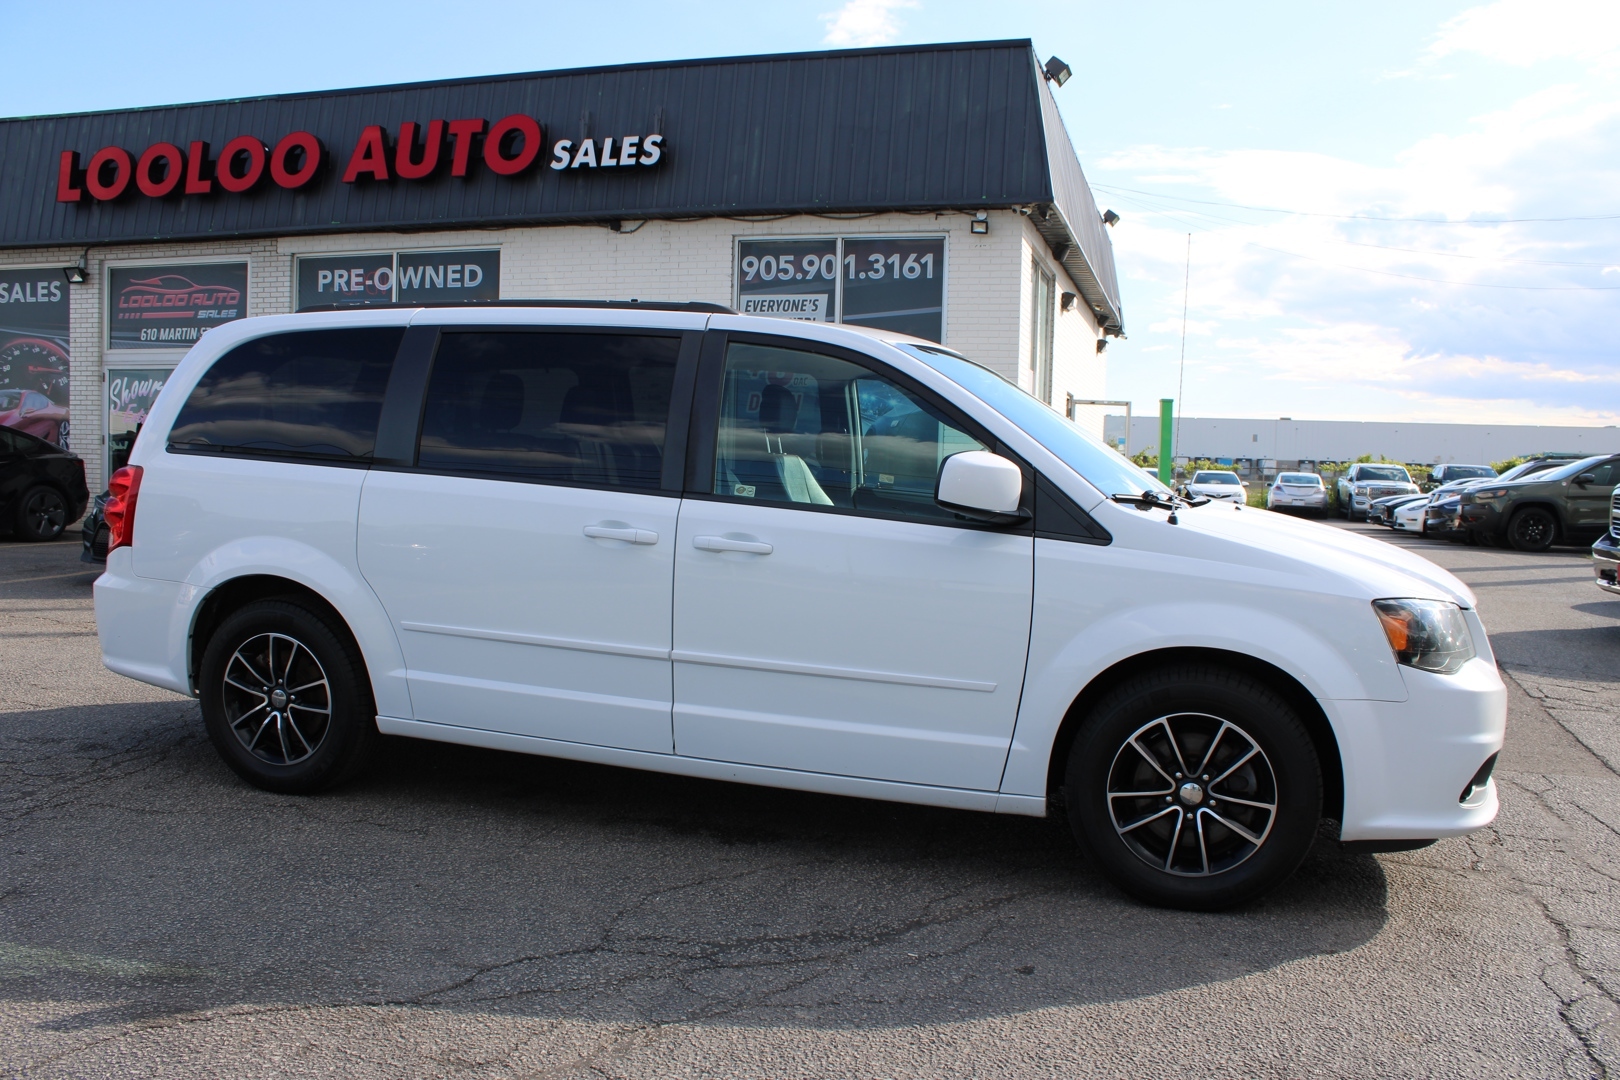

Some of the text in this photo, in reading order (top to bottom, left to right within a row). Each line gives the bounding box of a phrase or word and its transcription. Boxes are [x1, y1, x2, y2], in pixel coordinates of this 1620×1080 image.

[56, 113, 663, 203] LOOLOO AUTO SALES
[741, 253, 934, 281] 905.901.3161
[318, 264, 483, 292] PRE-OWNED
[0, 280, 62, 303] SALES
[118, 292, 240, 308] LOOLOO AUTO
[197, 309, 238, 319] SALES
[745, 299, 819, 313] EVERYONE'S
[141, 328, 157, 341] 610
[160, 327, 198, 340] MARTIN
